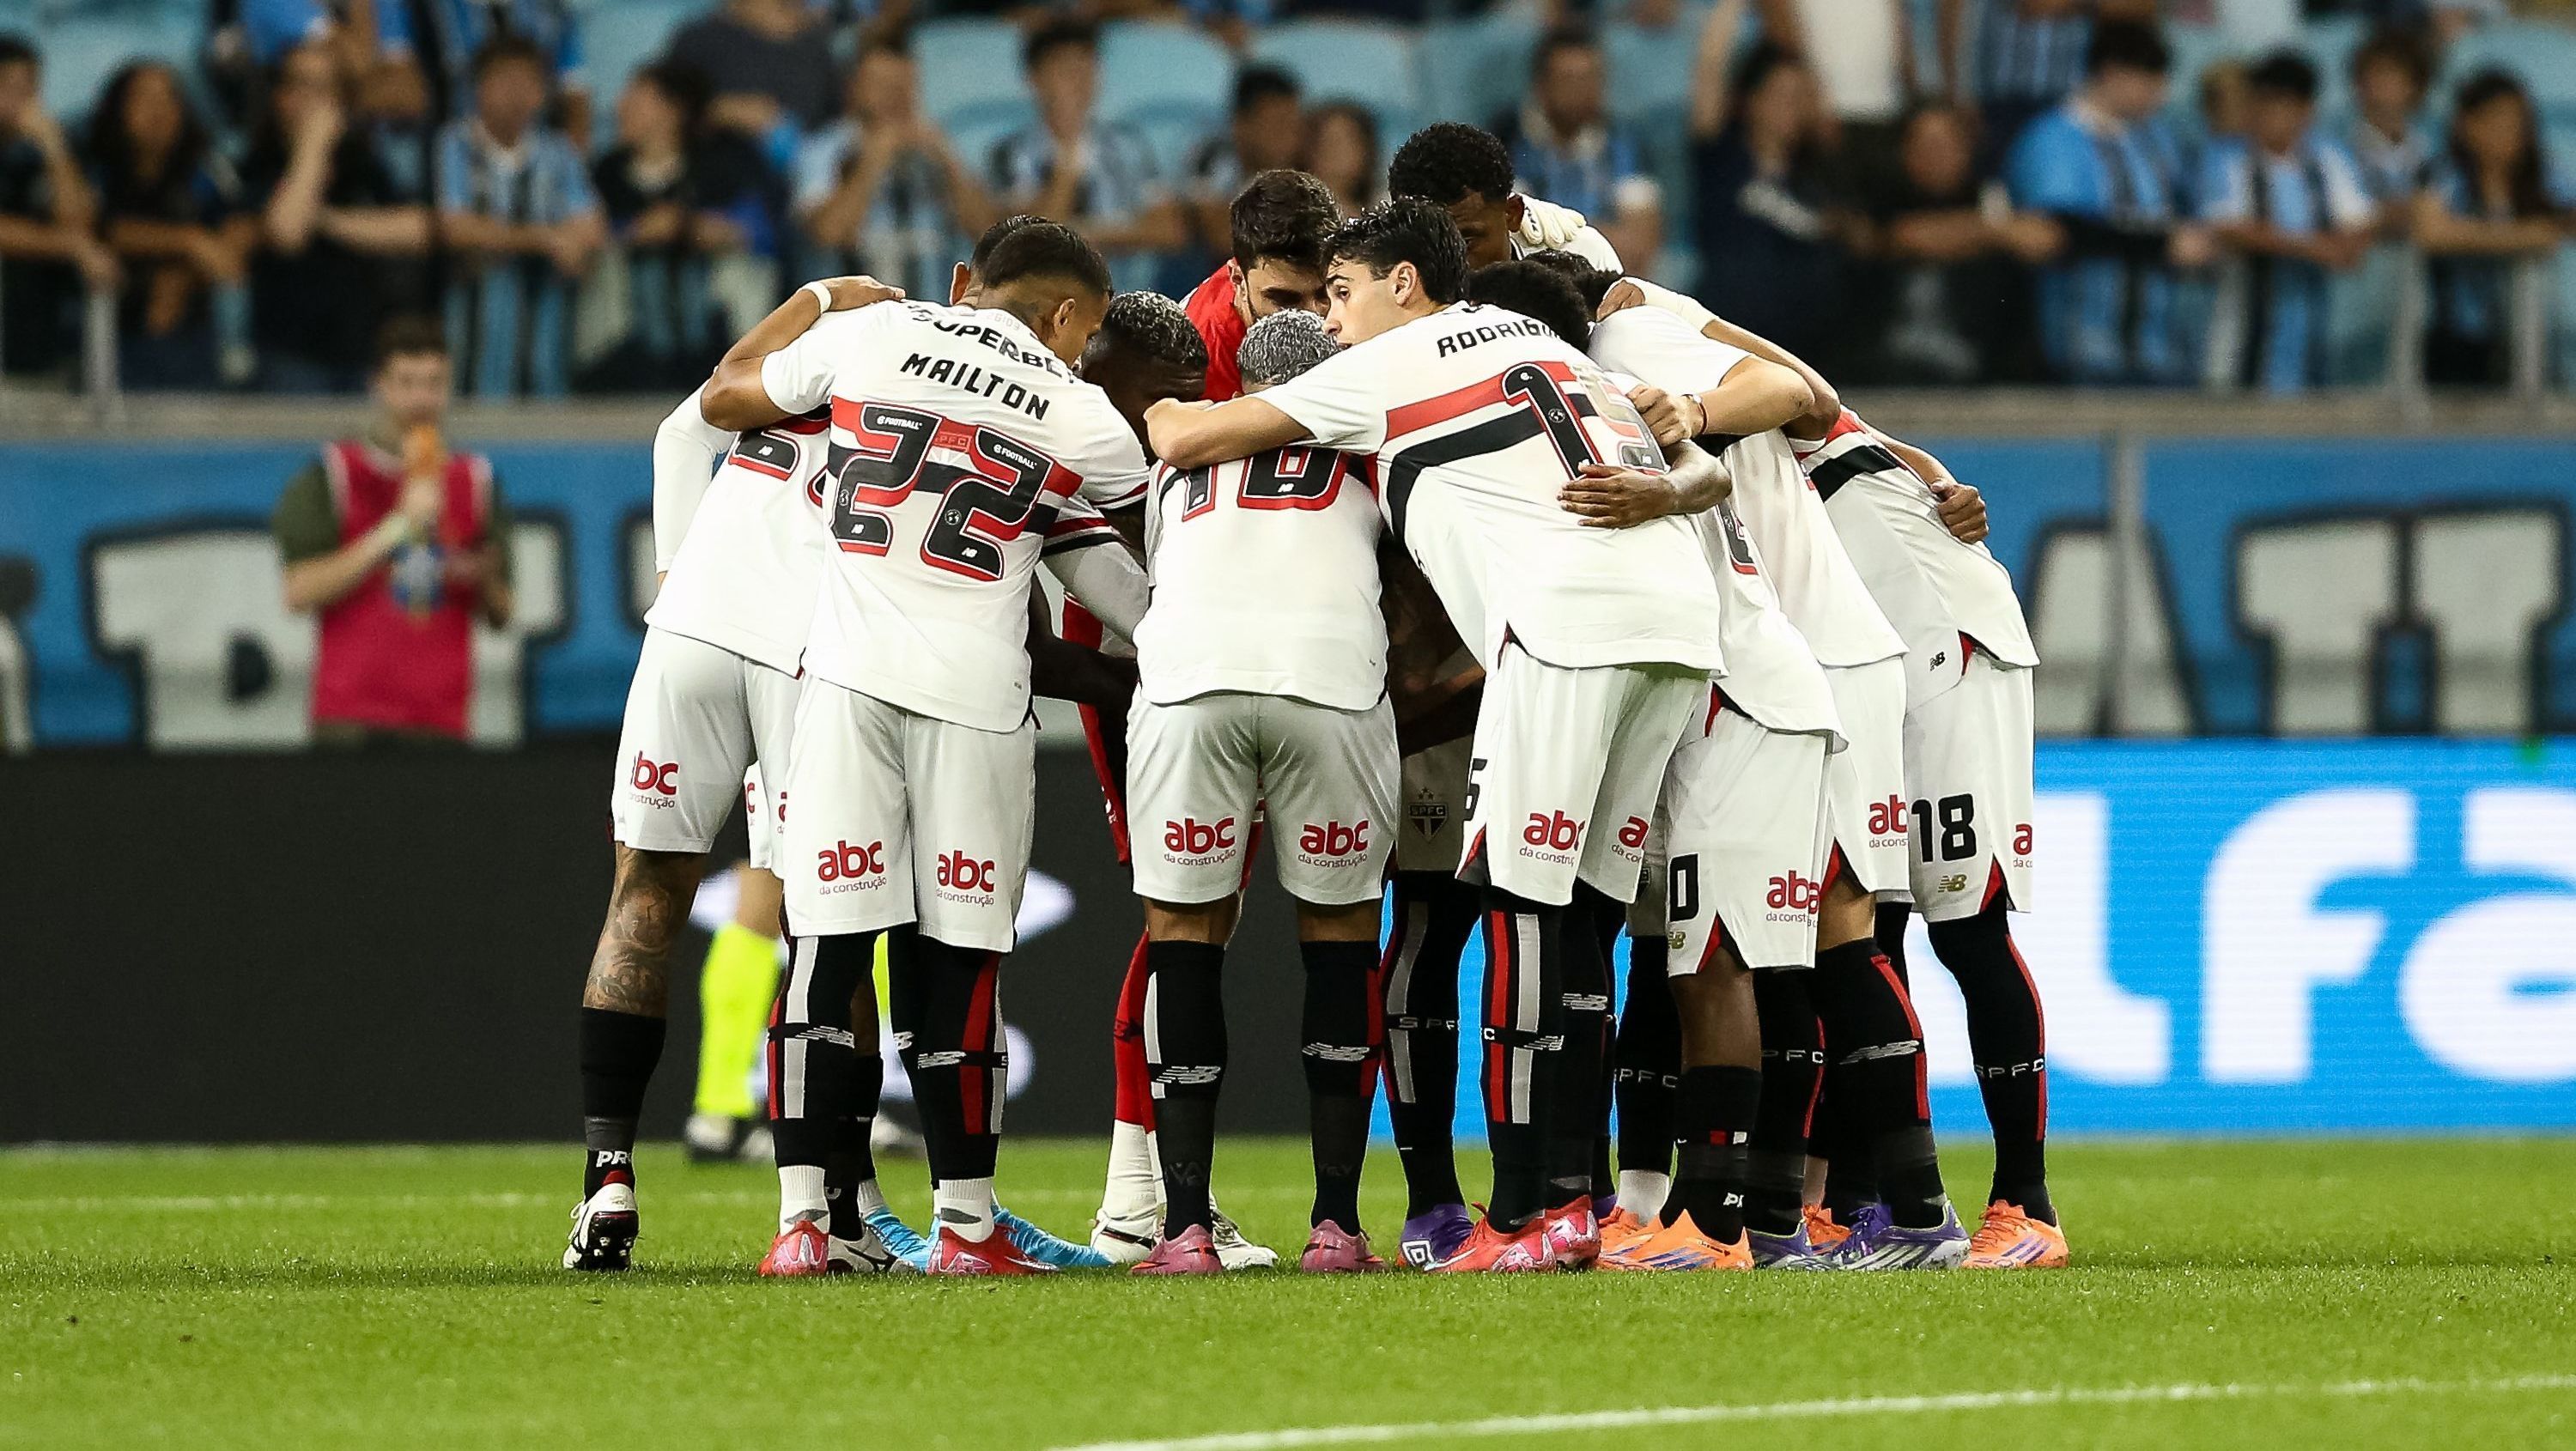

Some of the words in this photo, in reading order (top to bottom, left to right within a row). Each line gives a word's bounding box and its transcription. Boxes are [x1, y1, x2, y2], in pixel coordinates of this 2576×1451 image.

[900, 353, 1049, 421] MAILTON
[829, 402, 1055, 582] 22
[630, 750, 679, 796] bc
[1868, 794, 1908, 835] ab
[1911, 793, 1978, 863] 18
[1164, 817, 1236, 854] abc
[1300, 820, 1370, 857] abc
[1520, 846, 1534, 857] da
[818, 840, 884, 882] abc
[937, 850, 995, 893] abc
[1164, 853, 1176, 864] da
[1177, 849, 1236, 866] construção
[1298, 853, 1312, 865] da
[1314, 853, 1368, 867] construção
[819, 885, 831, 895] da
[833, 877, 887, 894] construção
[945, 891, 994, 908] construção
[1766, 870, 1809, 909] ab
[1766, 912, 1777, 921] da
[1779, 914, 1807, 923] const
[1908, 787, 2576, 1084] lfa
[1399, 1016, 1461, 1030] SPF
[1613, 1067, 1679, 1089] PFC
